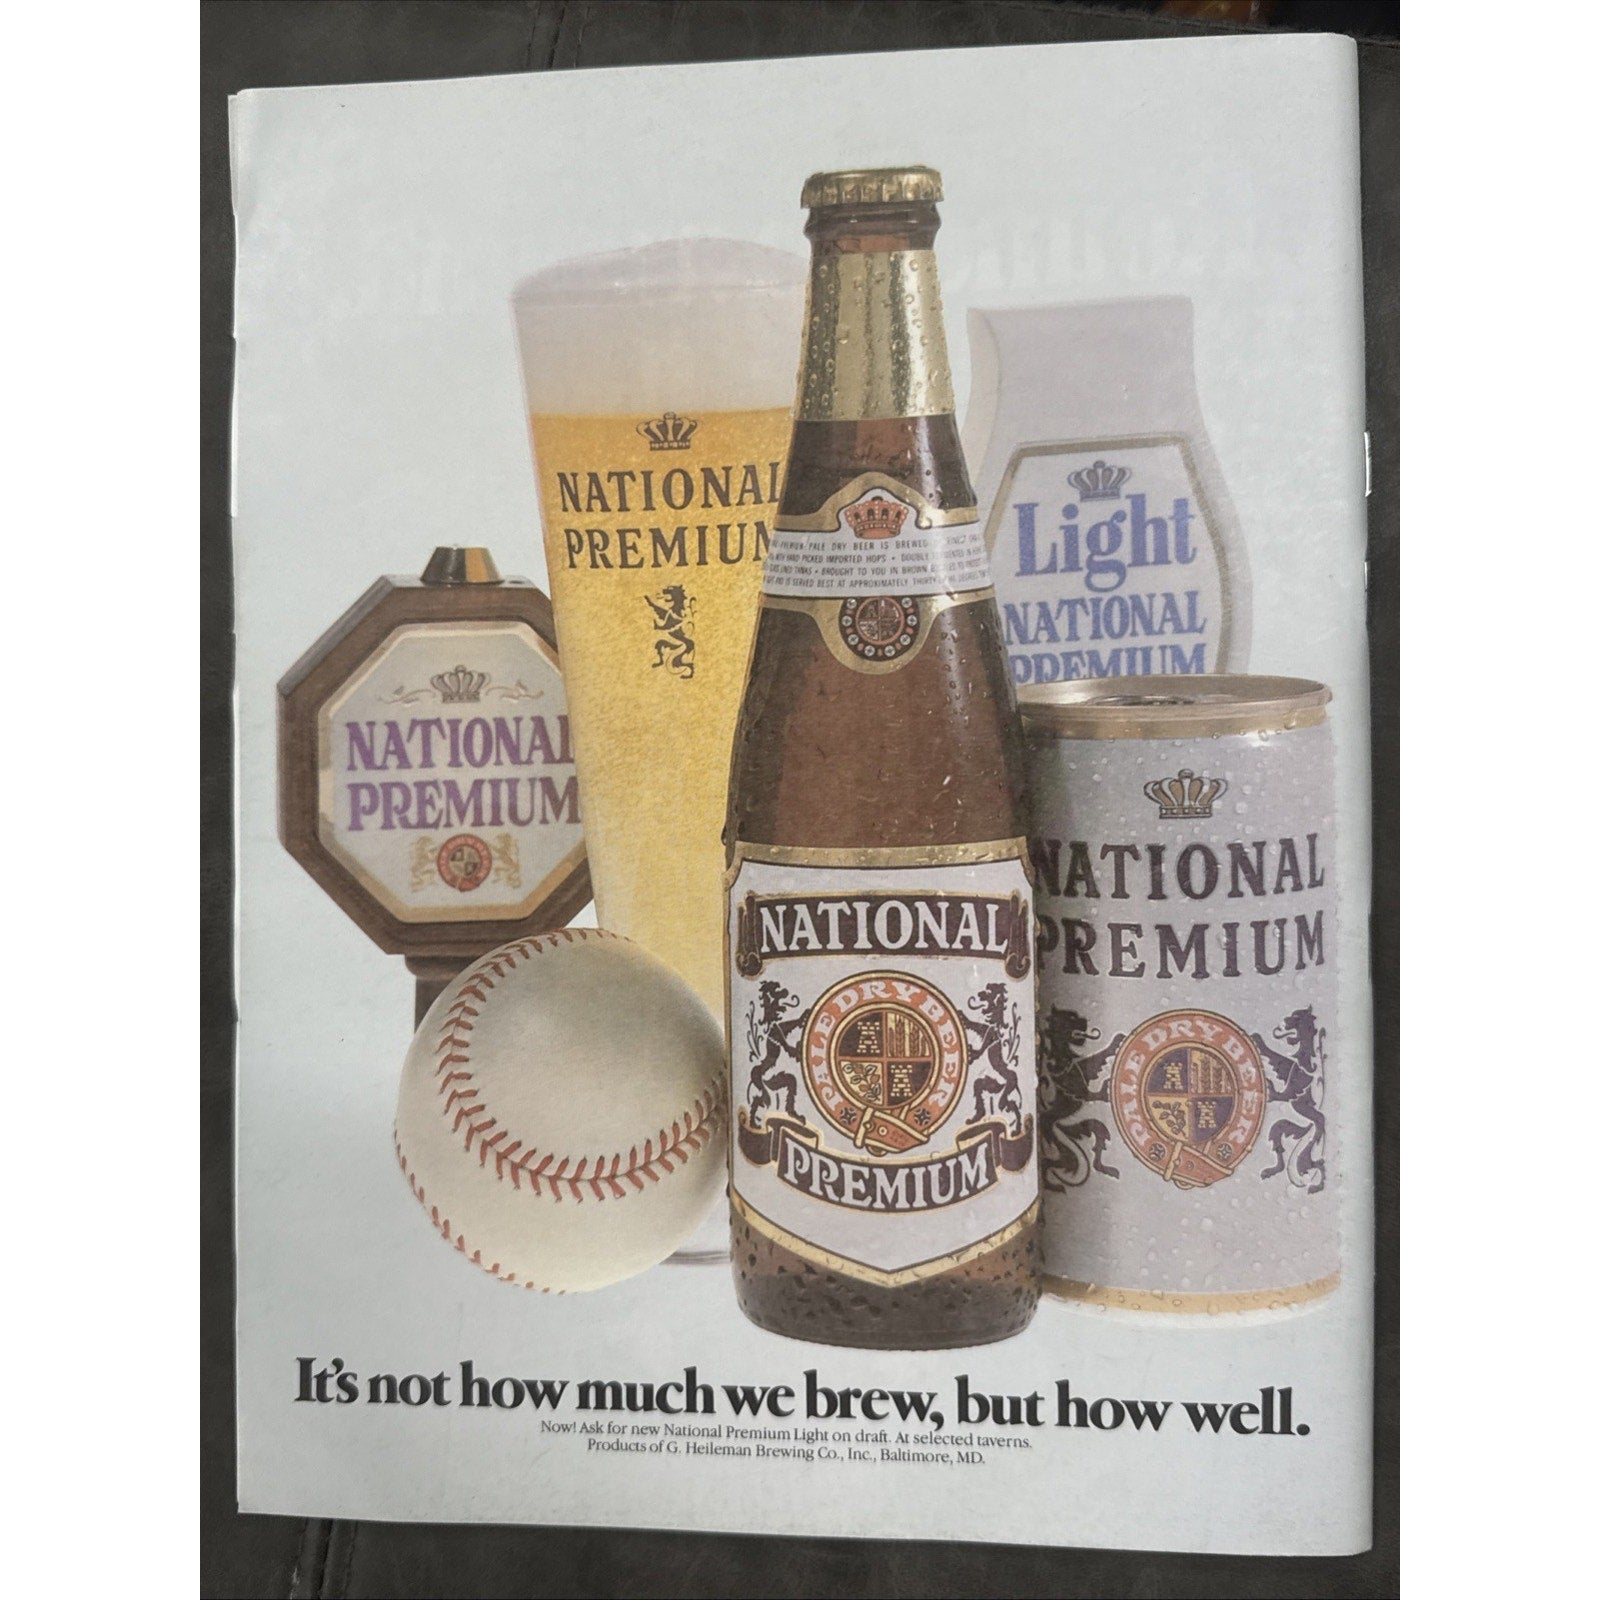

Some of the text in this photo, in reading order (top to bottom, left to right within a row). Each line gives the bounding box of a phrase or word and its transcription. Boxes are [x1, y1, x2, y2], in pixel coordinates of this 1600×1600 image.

[557, 462, 782, 512] NATIONAL
[801, 554, 823, 563] PICKED
[826, 554, 862, 563] IMPORTED
[866, 554, 887, 563] HOPS
[809, 542, 825, 551] PALE
[831, 542, 847, 551] DRY
[853, 541, 875, 551] BEER
[881, 541, 889, 550] IS
[896, 539, 929, 549] BREWED
[1013, 493, 1197, 592] Light
[792, 578, 814, 587] SERVED
[817, 579, 834, 588] BEST
[837, 579, 846, 588] AT
[849, 579, 908, 588] APPROXIMATELY
[821, 566, 854, 576] BROUGHT
[857, 567, 867, 576] TO
[871, 567, 886, 576] YOU
[890, 566, 898, 575] IN
[902, 565, 928, 575] BROWN
[1003, 590, 1207, 645] NATIONAL
[345, 714, 575, 771] NATIONAL
[347, 776, 581, 831] PREMIUM
[1030, 833, 1325, 900] NATIONAL
[760, 899, 1008, 953] NATIONAL
[1036, 910, 1324, 980] PREMIUM
[810, 980, 960, 1112] PALE DRY BEER
[1121, 1019, 1258, 1146] PALE DRY BEER
[783, 1138, 989, 1209] PREMIUM
[294, 1356, 1311, 1436] It's not how much we brew, but how well.
[541, 1420, 1033, 1448] Now! Ask for new National Premium Light on draft. At selected taverns.
[587, 1438, 986, 1465] Products of G. Heileman Brewing Co., Inc., Baltimore, MD.
